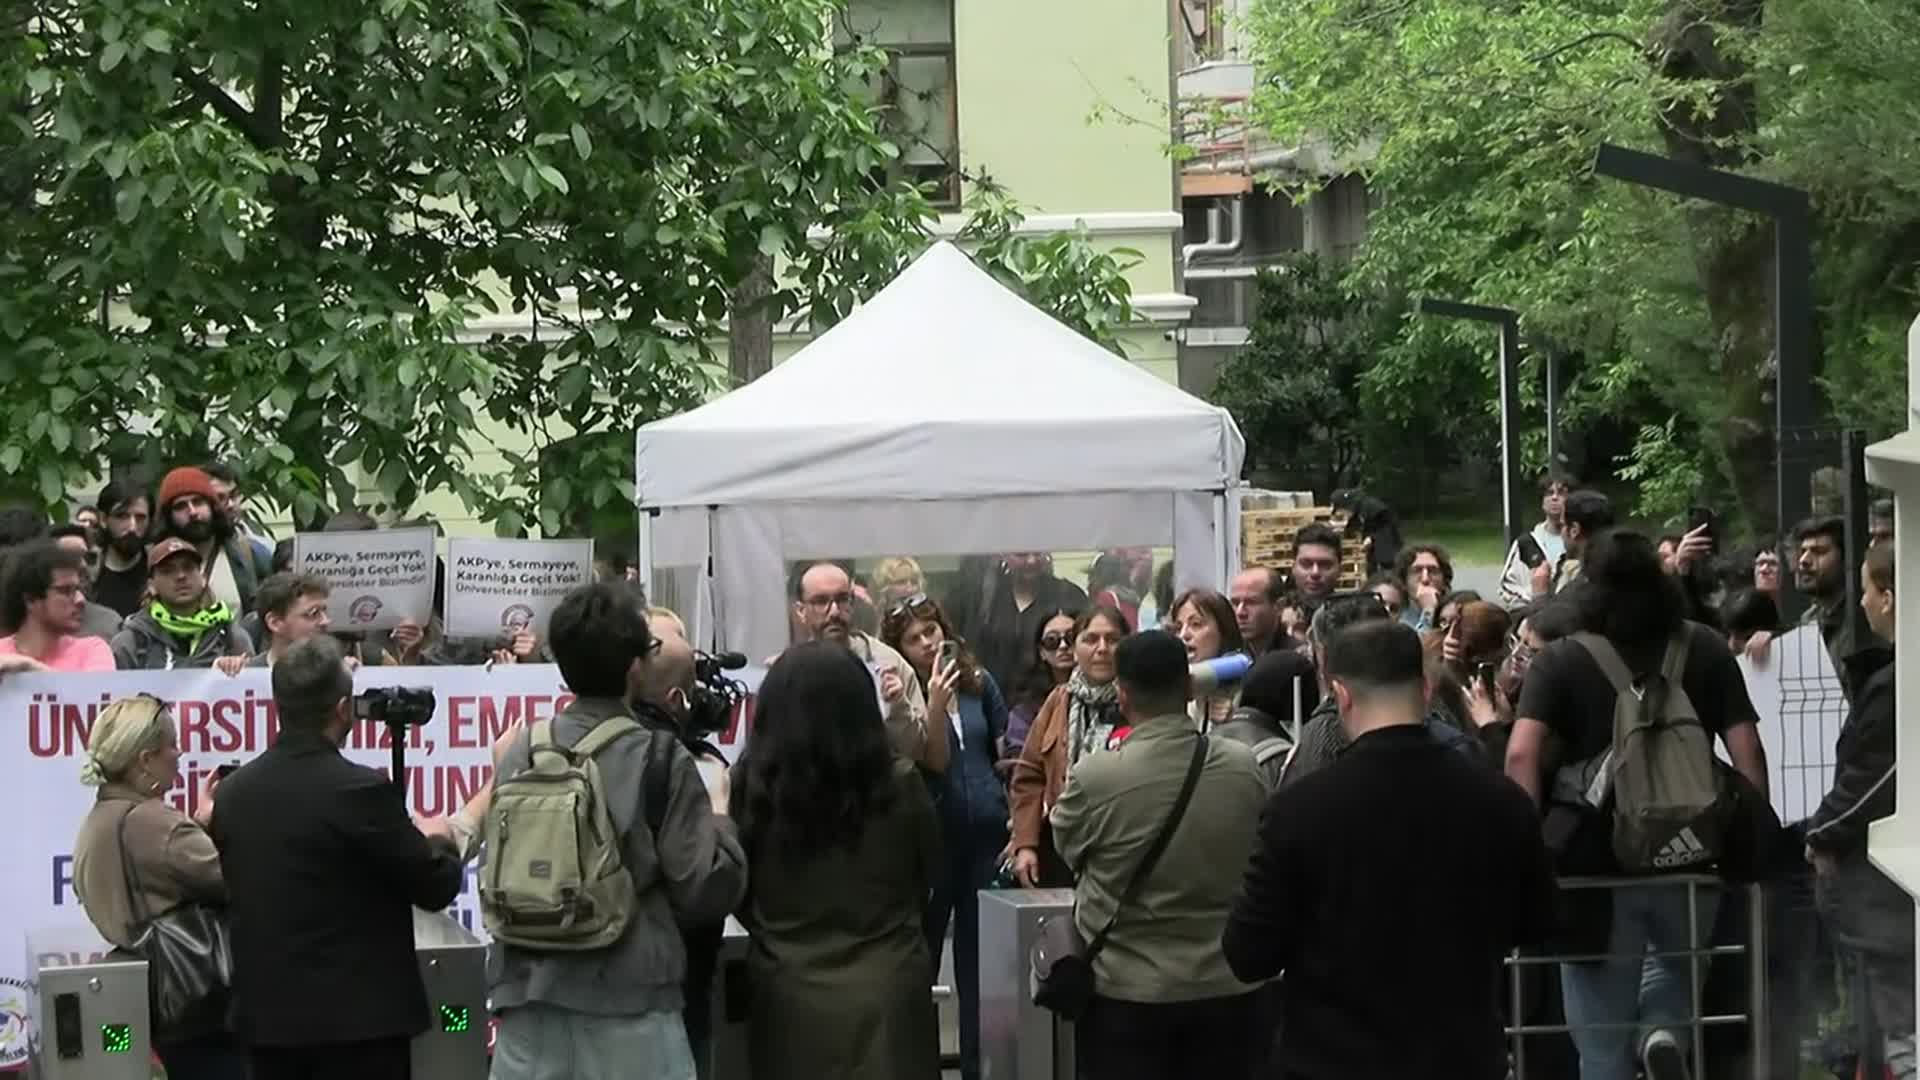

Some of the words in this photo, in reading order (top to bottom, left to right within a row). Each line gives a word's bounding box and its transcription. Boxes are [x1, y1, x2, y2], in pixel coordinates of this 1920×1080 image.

[356, 549, 424, 562] Sermayeye,
[368, 563, 400, 577] Geçit
[456, 556, 506, 569] AKP'ye,
[508, 558, 579, 571] Sermayeye,
[456, 570, 516, 584] Karanlığa
[520, 573, 552, 585] Geçit
[555, 573, 581, 584] Yok!
